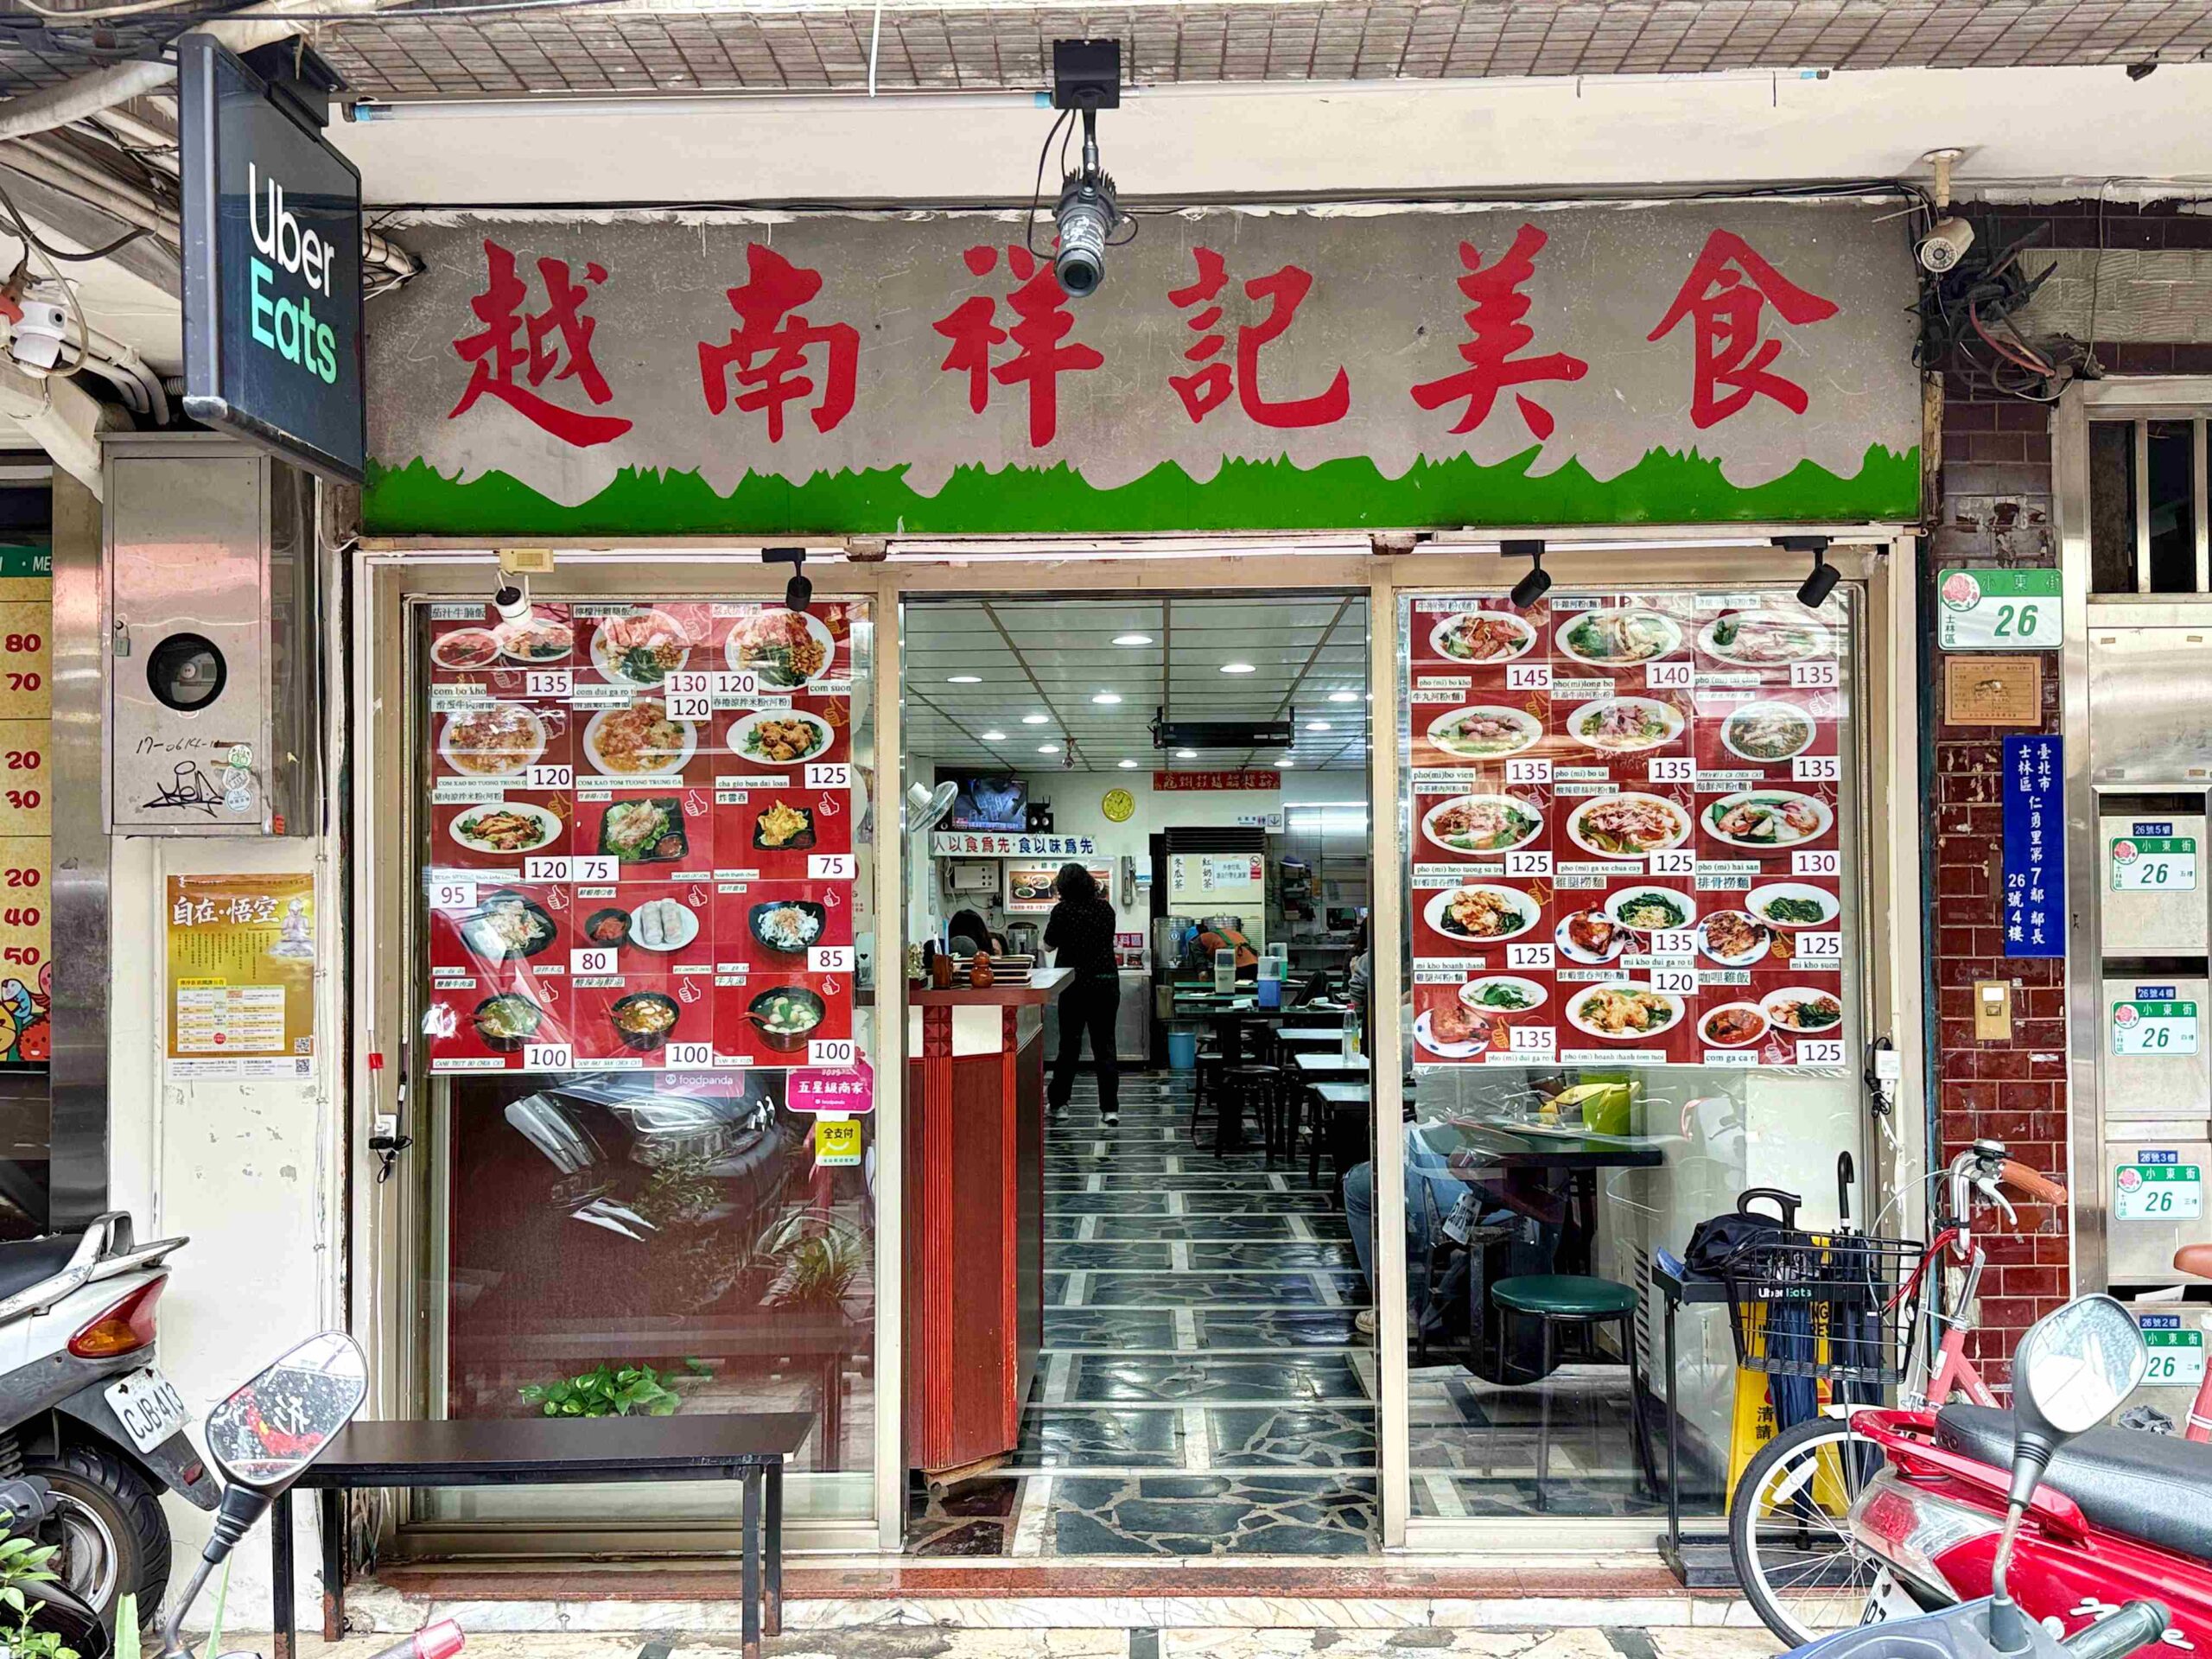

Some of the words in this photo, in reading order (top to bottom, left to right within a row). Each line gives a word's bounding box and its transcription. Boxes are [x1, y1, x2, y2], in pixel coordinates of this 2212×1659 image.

[249, 161, 335, 297] Uber
[251, 257, 338, 385] Eats
[448, 222, 1840, 448] 越南祥記美食
[1981, 572, 2060, 593] 小東街
[1945, 614, 1955, 644] 士林區
[1994, 604, 2038, 637] 26
[1512, 670, 1548, 686] 145
[1653, 666, 1689, 684] 140
[1796, 666, 1834, 683] 135
[532, 676, 567, 693] 135
[671, 676, 707, 692] 130
[719, 676, 754, 692] 120
[673, 699, 709, 715] 120
[812, 767, 846, 784] 125
[1512, 763, 1548, 780] 135
[1655, 762, 1690, 779] 135
[1799, 760, 1834, 778] 135
[2018, 744, 2032, 791] 士林區
[2037, 743, 2051, 792] 臺北市
[534, 768, 570, 785] 120
[1697, 782, 1751, 791] 海鮮河粉(麵)
[718, 793, 747, 803] 炸雲吞
[2142, 840, 2191, 852] 小東街
[531, 861, 566, 879] 120
[584, 862, 607, 879] 75
[820, 857, 843, 874] 75
[1512, 855, 1548, 872] 125
[1657, 855, 1692, 871] 125
[1798, 855, 1834, 872] 130
[1173, 857, 1184, 890] 冬瓜茶
[1202, 857, 1213, 889] 紅奶茶
[2140, 863, 2169, 884] 26
[1555, 877, 1605, 888] 雞腿撈麵
[1698, 877, 1750, 889] 排骨撈麵
[442, 887, 465, 904] 95
[172, 895, 281, 926] 自在·悟空
[2008, 874, 2025, 942] 26號4樓
[1656, 934, 1692, 950] 135
[1803, 938, 1839, 955] 125
[582, 953, 606, 970] 80
[820, 950, 843, 967] 85
[1515, 947, 1550, 964] 125
[1657, 974, 1693, 990] 120
[2143, 1004, 2192, 1015] 小東街
[1516, 1031, 1551, 1048] 135
[2142, 1027, 2170, 1048] 26
[531, 1048, 567, 1066] 100
[672, 1046, 708, 1064] 100
[815, 1042, 850, 1059] 100
[1804, 1044, 1840, 1061] 125
[678, 1073, 734, 1087] foodpanda
[798, 1081, 863, 1094] 五星級商家
[823, 1128, 854, 1139] 全支付
[2139, 1152, 2177, 1163] 26號3樓
[2145, 1167, 2196, 1180] 小東街
[2145, 1192, 2173, 1211] 26
[2141, 1318, 2178, 1328] 26號2樓
[2148, 1332, 2198, 1345] 小東街
[2147, 1357, 2176, 1377] 26
